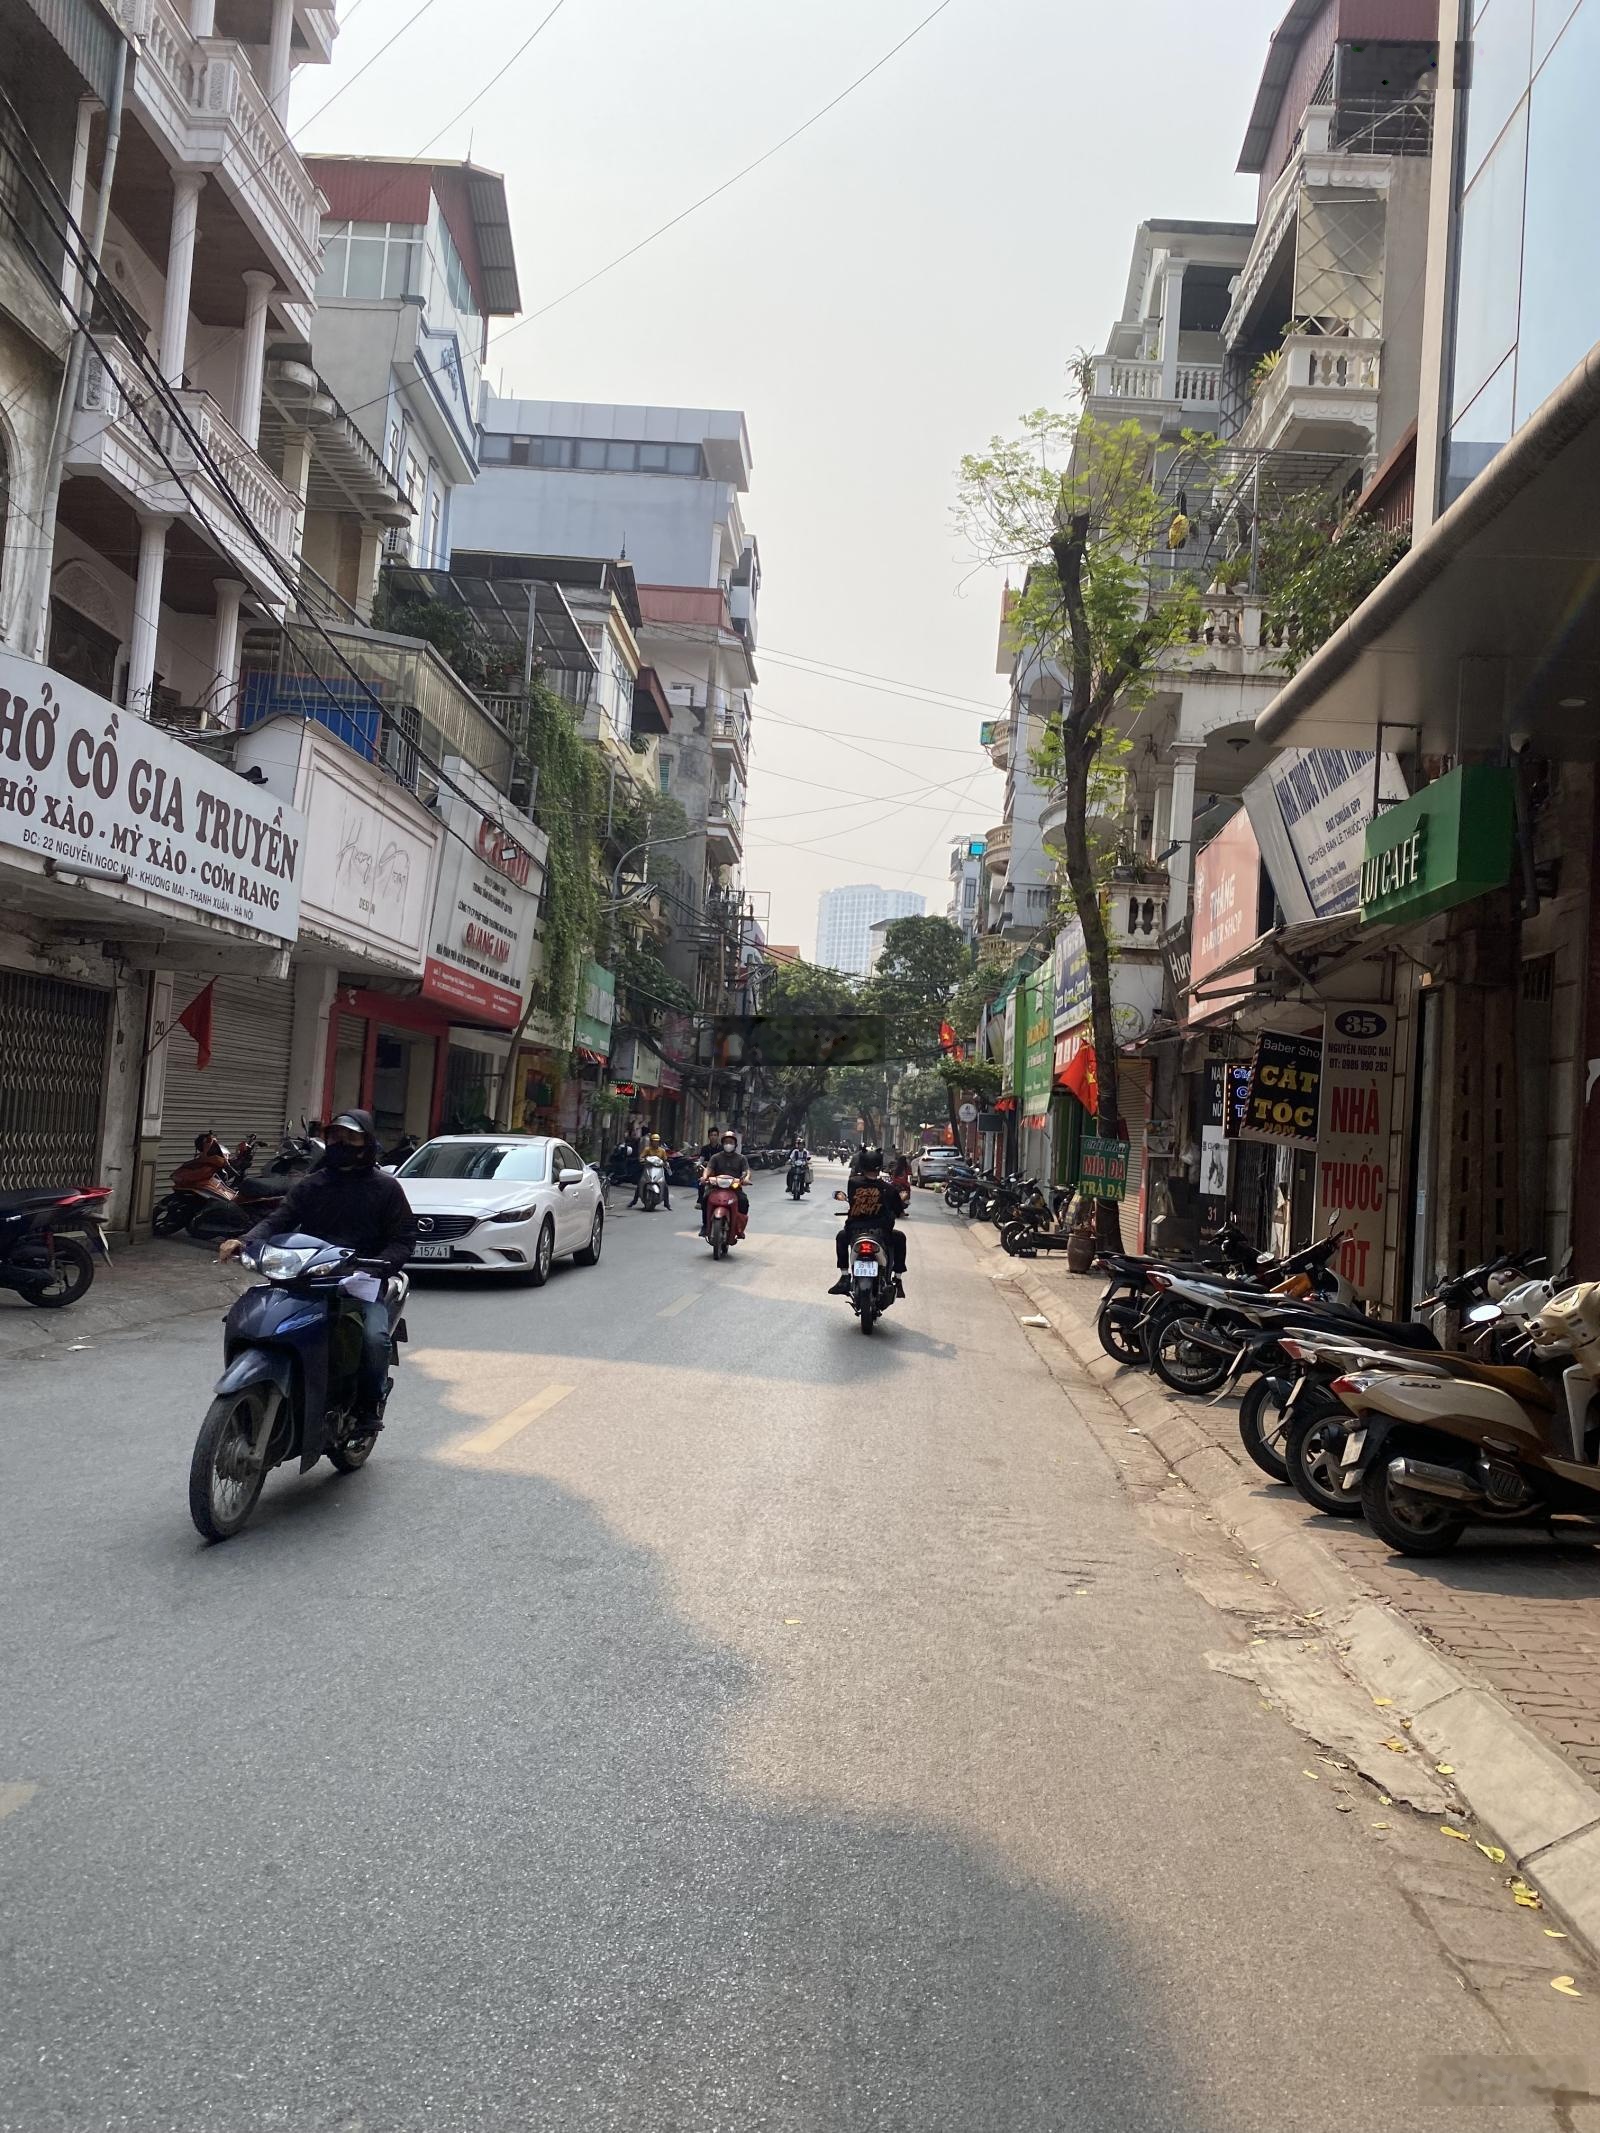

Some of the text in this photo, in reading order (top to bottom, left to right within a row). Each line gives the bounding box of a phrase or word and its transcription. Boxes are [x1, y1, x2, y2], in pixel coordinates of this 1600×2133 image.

[0, 683, 60, 771] HỞ
[128, 759, 185, 833] GIA
[196, 789, 299, 883] TRUYỀN
[1350, 798, 1361, 817] GPP
[0, 775, 38, 816] HỞ
[41, 795, 94, 838] XÀO
[110, 823, 143, 857] MỲ
[145, 838, 187, 874] XÀO
[200, 861, 236, 894] CƠM
[237, 875, 280, 911] RANG
[1381, 817, 1421, 896] CAFÉ
[23, 829, 40, 847] ĐC:
[42, 836, 53, 851] 22
[55, 840, 93, 864] NGUYỄN
[171, 881, 185, 897] MAI
[466, 922, 511, 962] QUANG ANH
[155, 1020, 165, 1035] 20
[1345, 1016, 1377, 1034] 35
[1263, 1039, 1322, 1059] Baber Sho
[1211, 1066, 1223, 1080] NA
[1261, 1061, 1319, 1093] CẮT
[1215, 1083, 1222, 1098] &
[1254, 1098, 1315, 1127] TÓC
[1330, 1079, 1380, 1135] NHÀ
[1263, 1121, 1296, 1135] NAM
[1082, 1152, 1106, 1178] MÍA
[1081, 1178, 1123, 1200] TRÀ ĐÁ
[1321, 1148, 1384, 1212] THUỐC
[1207, 1206, 1217, 1221] 31
[1332, 1222, 1371, 1288] ỐT
